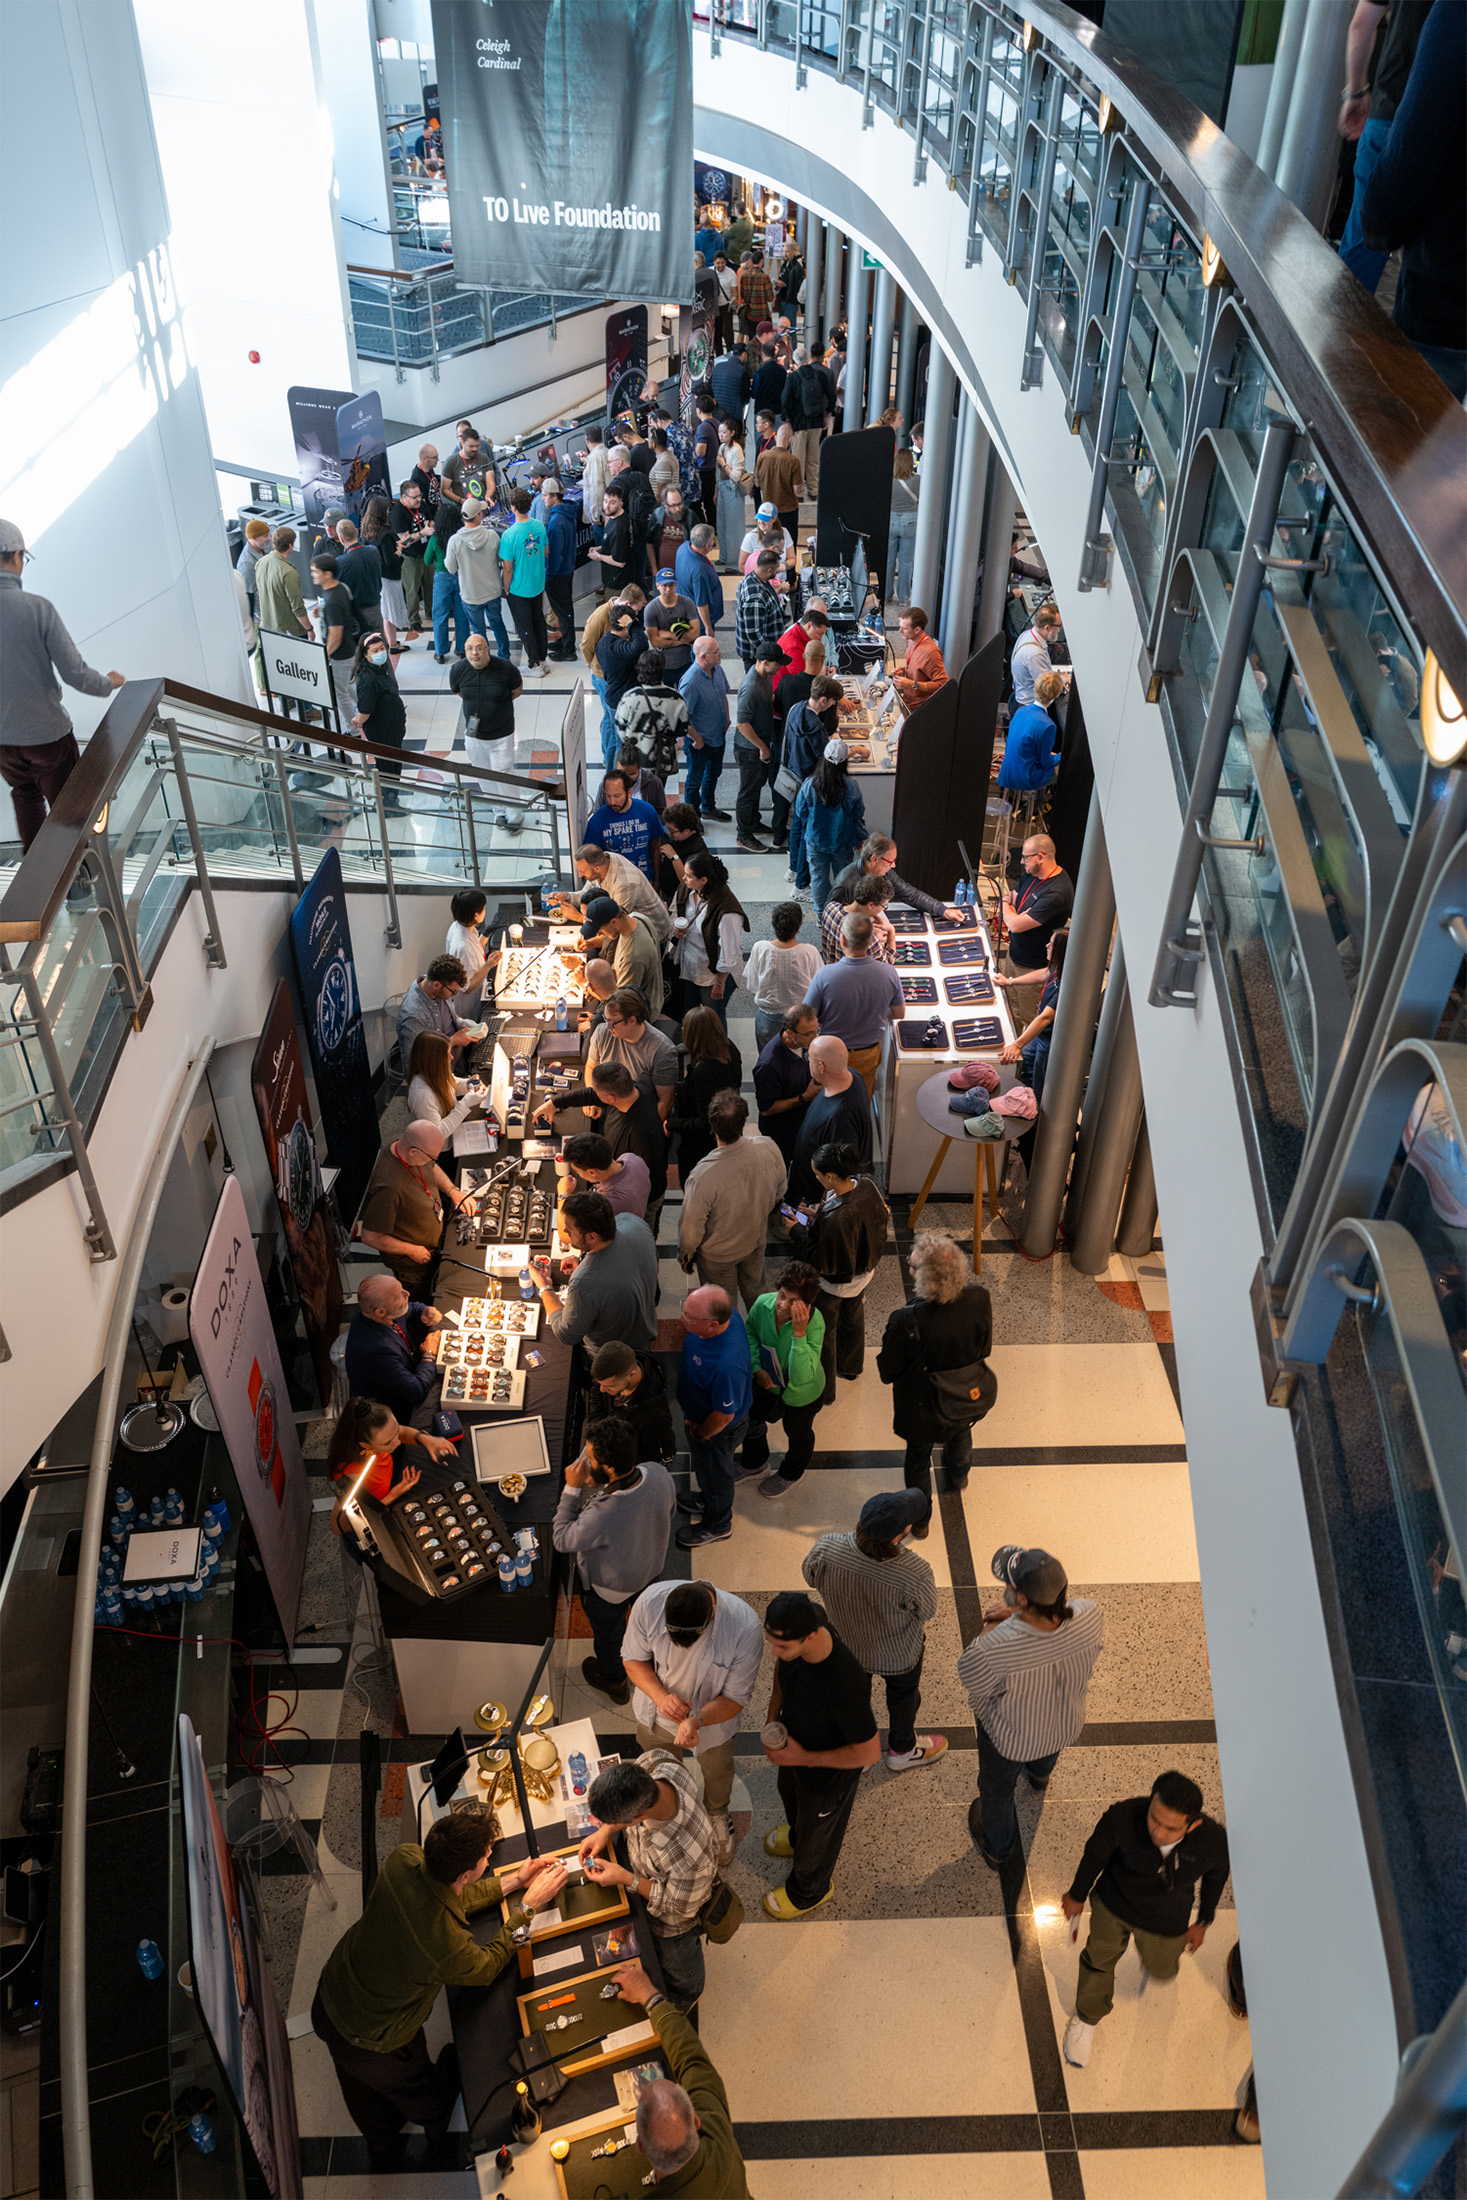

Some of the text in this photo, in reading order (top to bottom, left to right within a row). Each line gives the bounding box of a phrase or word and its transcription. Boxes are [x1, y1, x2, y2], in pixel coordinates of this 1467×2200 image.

[476, 39, 511, 54] Celeigh
[477, 56, 521, 70] Cardinal
[483, 183, 661, 232] TO Live Foundation
[352, 416, 372, 429] MARATHON
[275, 658, 319, 687] Gallery
[603, 823, 648, 837] MY SPARE TIME
[211, 1237, 242, 1340] DOXA
[441, 1415, 450, 1430] DOXA
[171, 1541, 180, 1565] DOXA
